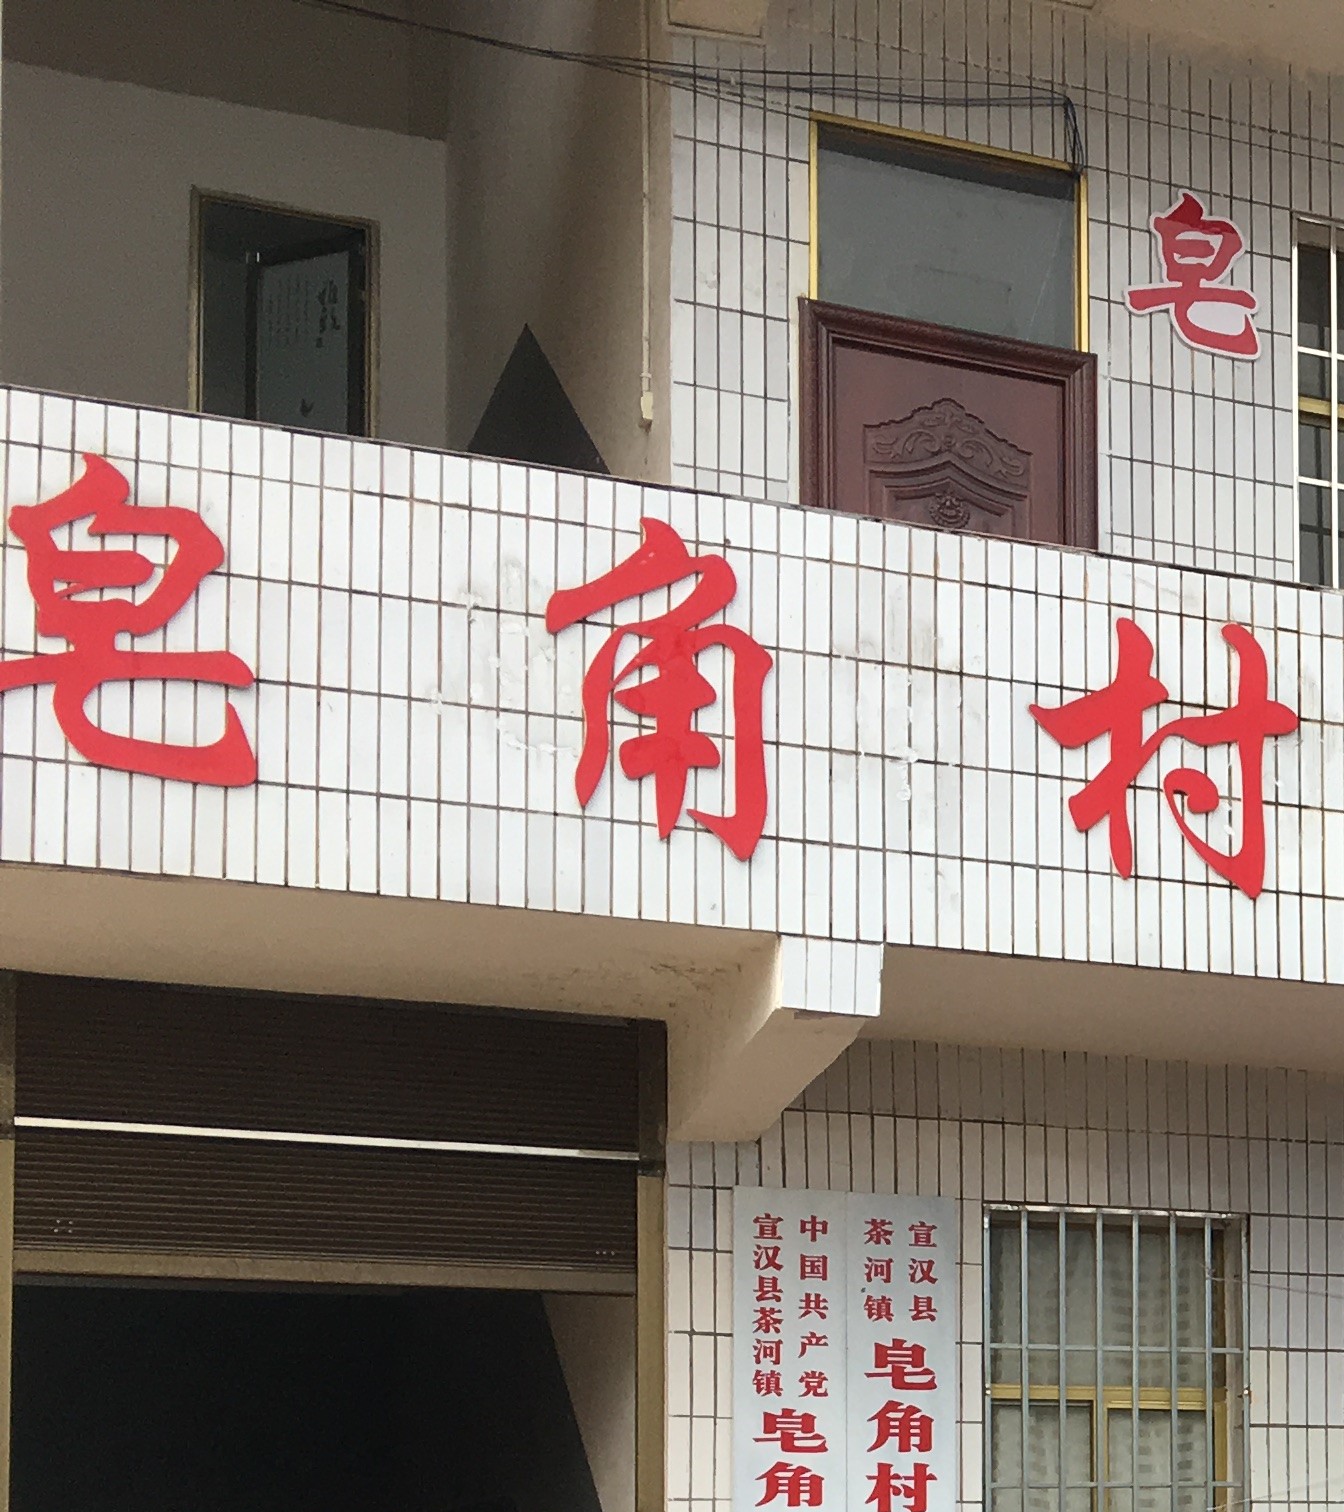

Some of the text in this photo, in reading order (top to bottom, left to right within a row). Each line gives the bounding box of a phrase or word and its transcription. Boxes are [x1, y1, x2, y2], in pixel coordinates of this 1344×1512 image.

[753, 1213, 784, 1397] 宣汉县茶河镇
[799, 1215, 829, 1397] 中国共产党
[863, 1218, 894, 1322] 茶河镇
[908, 1221, 938, 1323] 宣汉县
